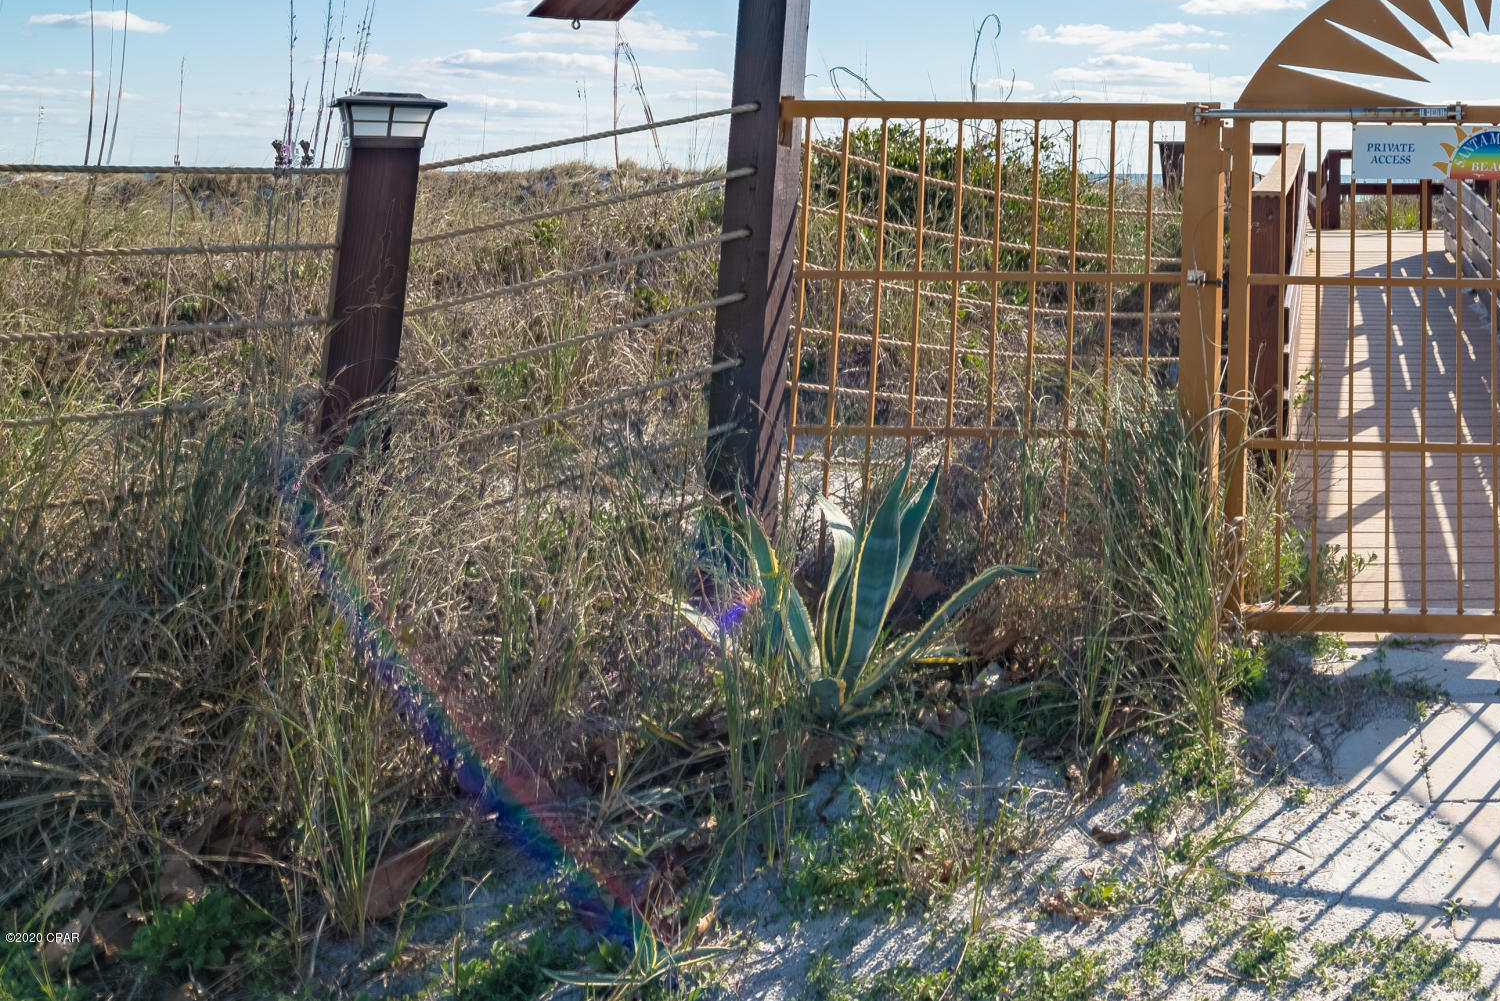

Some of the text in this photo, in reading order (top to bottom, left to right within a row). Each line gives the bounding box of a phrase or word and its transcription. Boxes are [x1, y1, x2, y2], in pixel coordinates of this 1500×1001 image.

[1367, 143, 1416, 153] PRIVATE
[1454, 134, 1488, 168] SANTA
[1370, 154, 1412, 165] ACCESS
